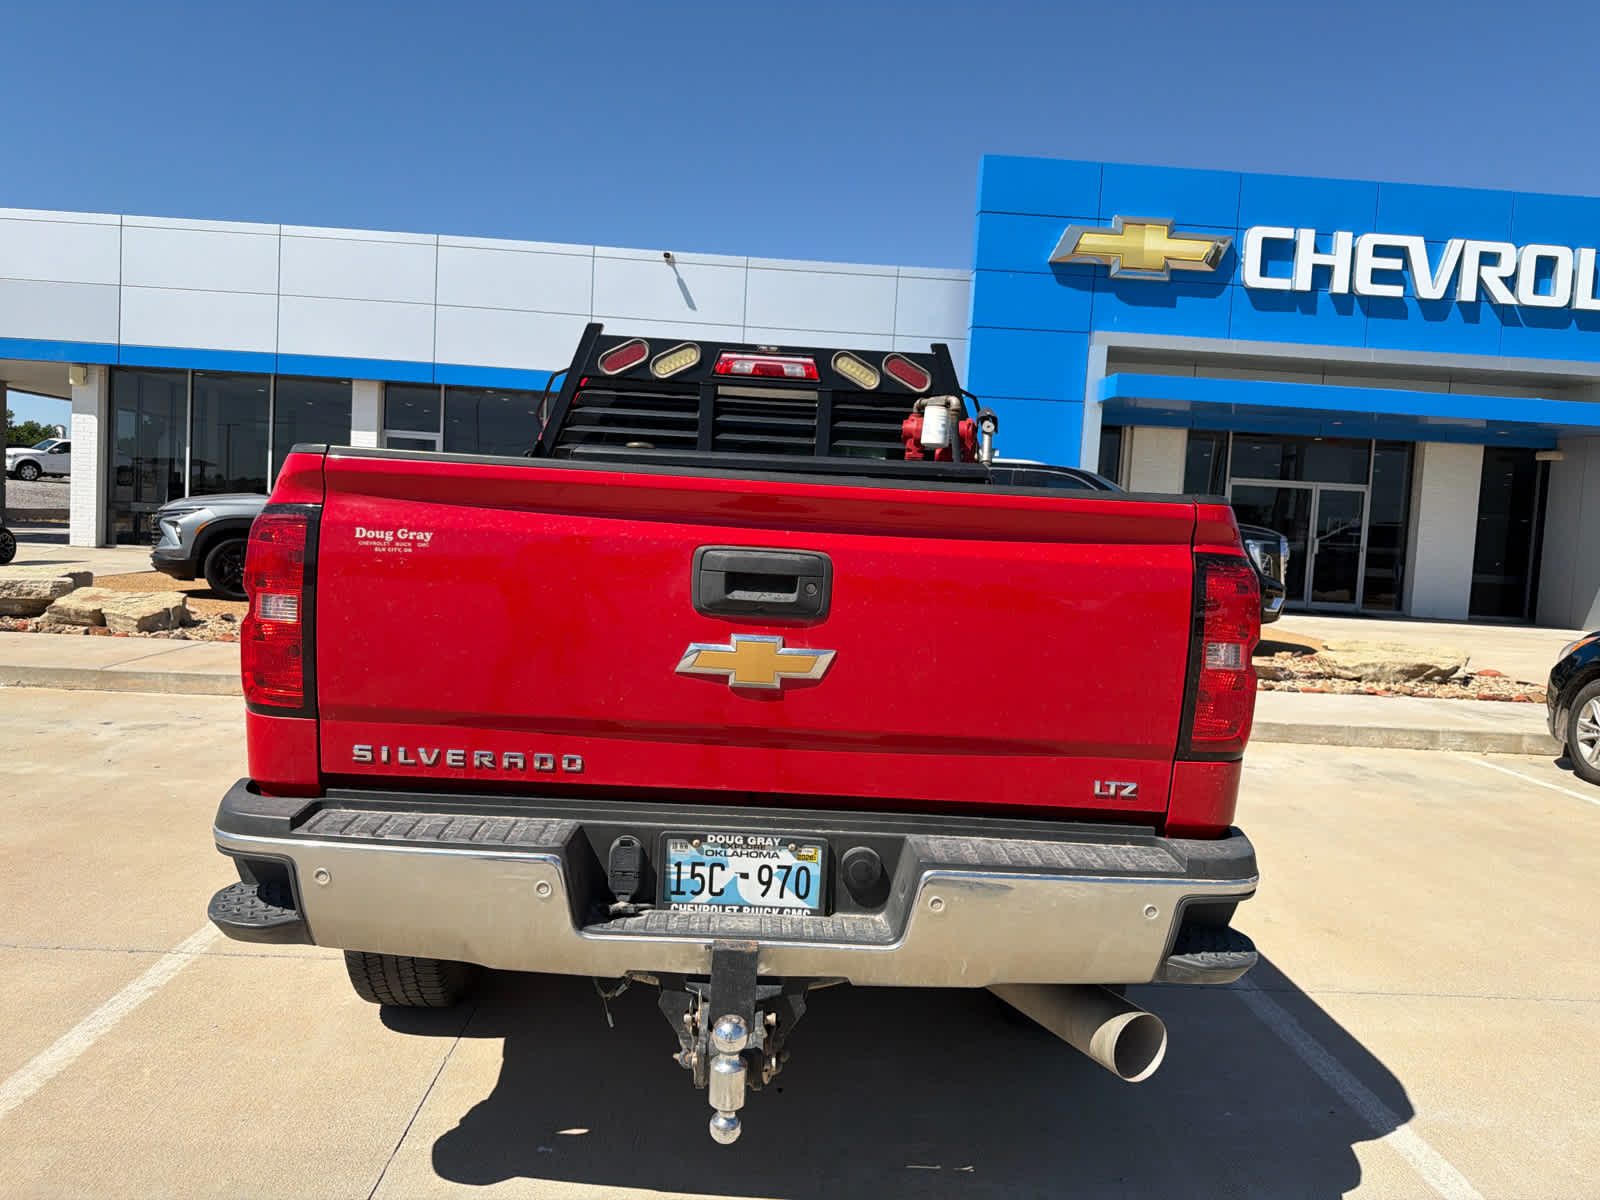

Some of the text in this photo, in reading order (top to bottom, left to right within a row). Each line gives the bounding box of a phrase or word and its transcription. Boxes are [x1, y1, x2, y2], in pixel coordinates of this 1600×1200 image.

[354, 526, 433, 542] Doug Gray
[352, 744, 584, 772] SILVERADO
[1094, 779, 1138, 798] LTZ
[707, 834, 781, 846] DOUG GRAY
[705, 849, 780, 859] OKLAHOMA
